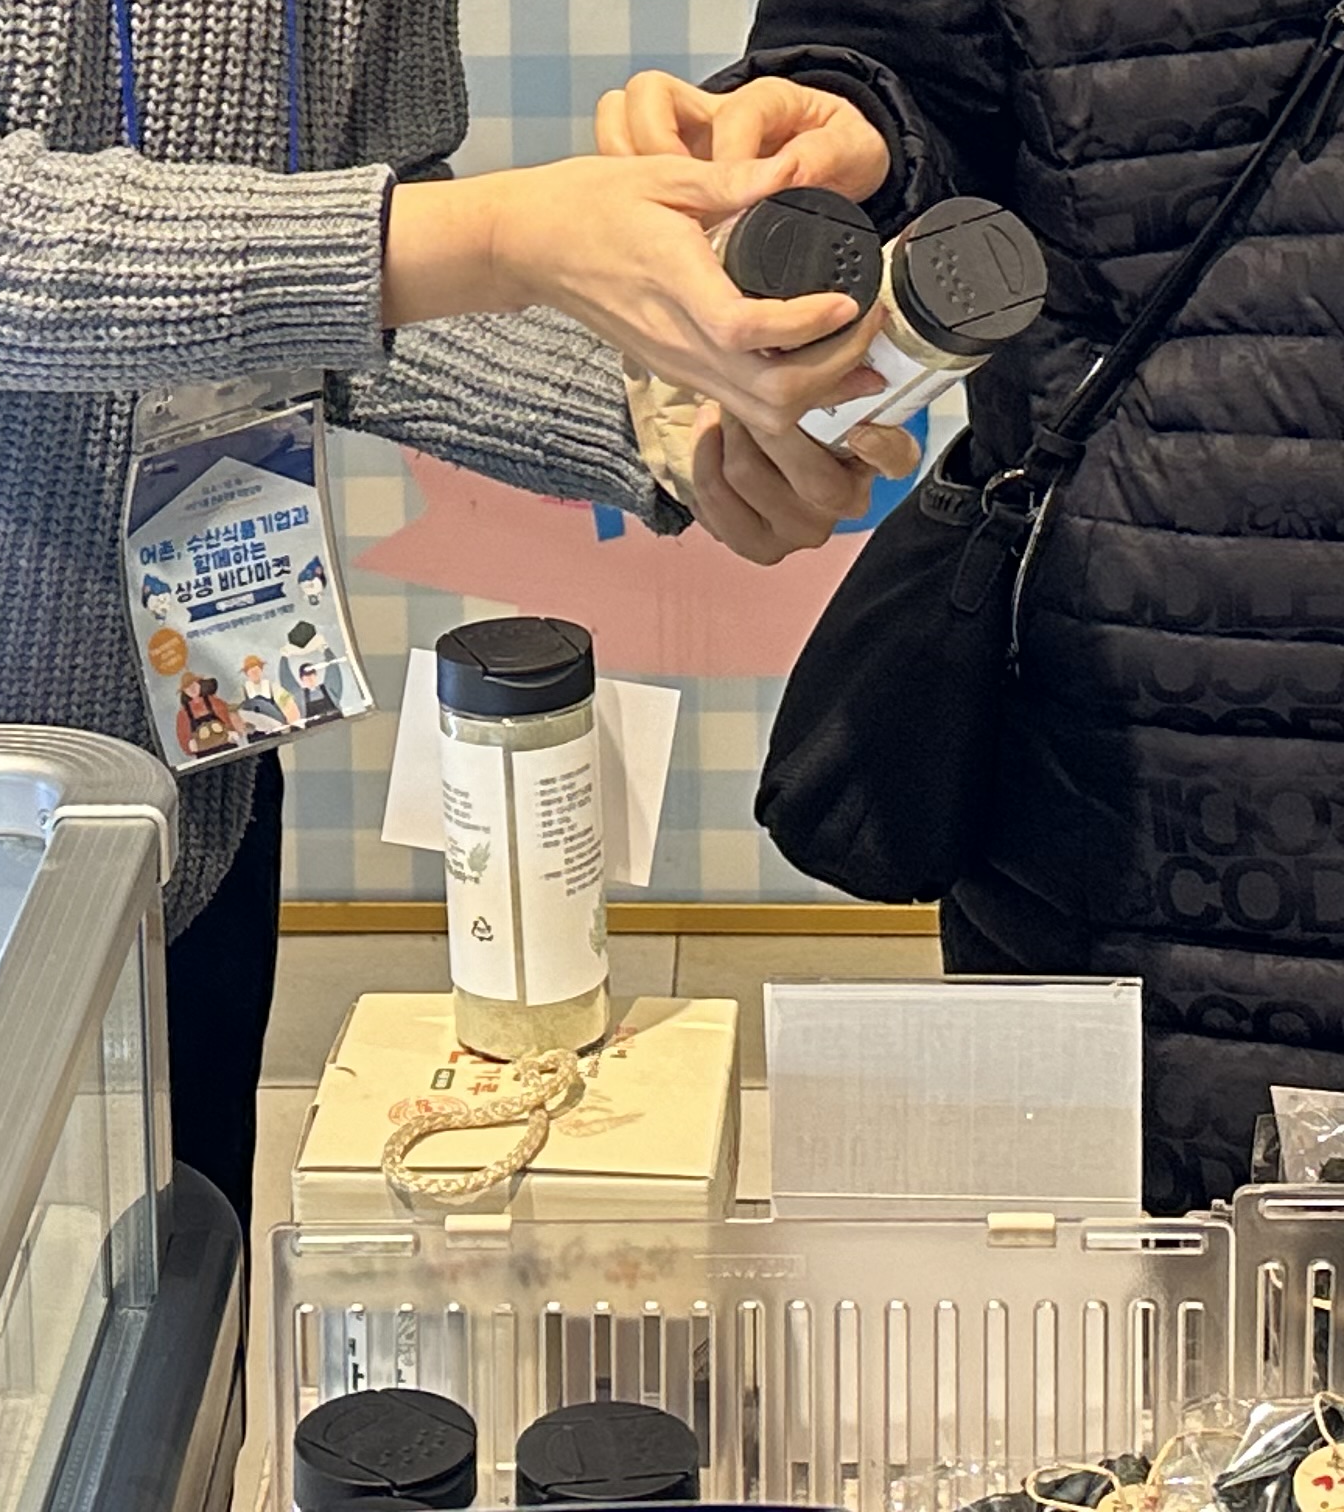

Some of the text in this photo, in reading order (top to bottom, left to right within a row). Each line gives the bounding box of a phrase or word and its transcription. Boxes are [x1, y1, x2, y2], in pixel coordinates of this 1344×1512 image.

[174, 554, 292, 604] 상생 바다마켓
[192, 540, 267, 576] 함께하는
